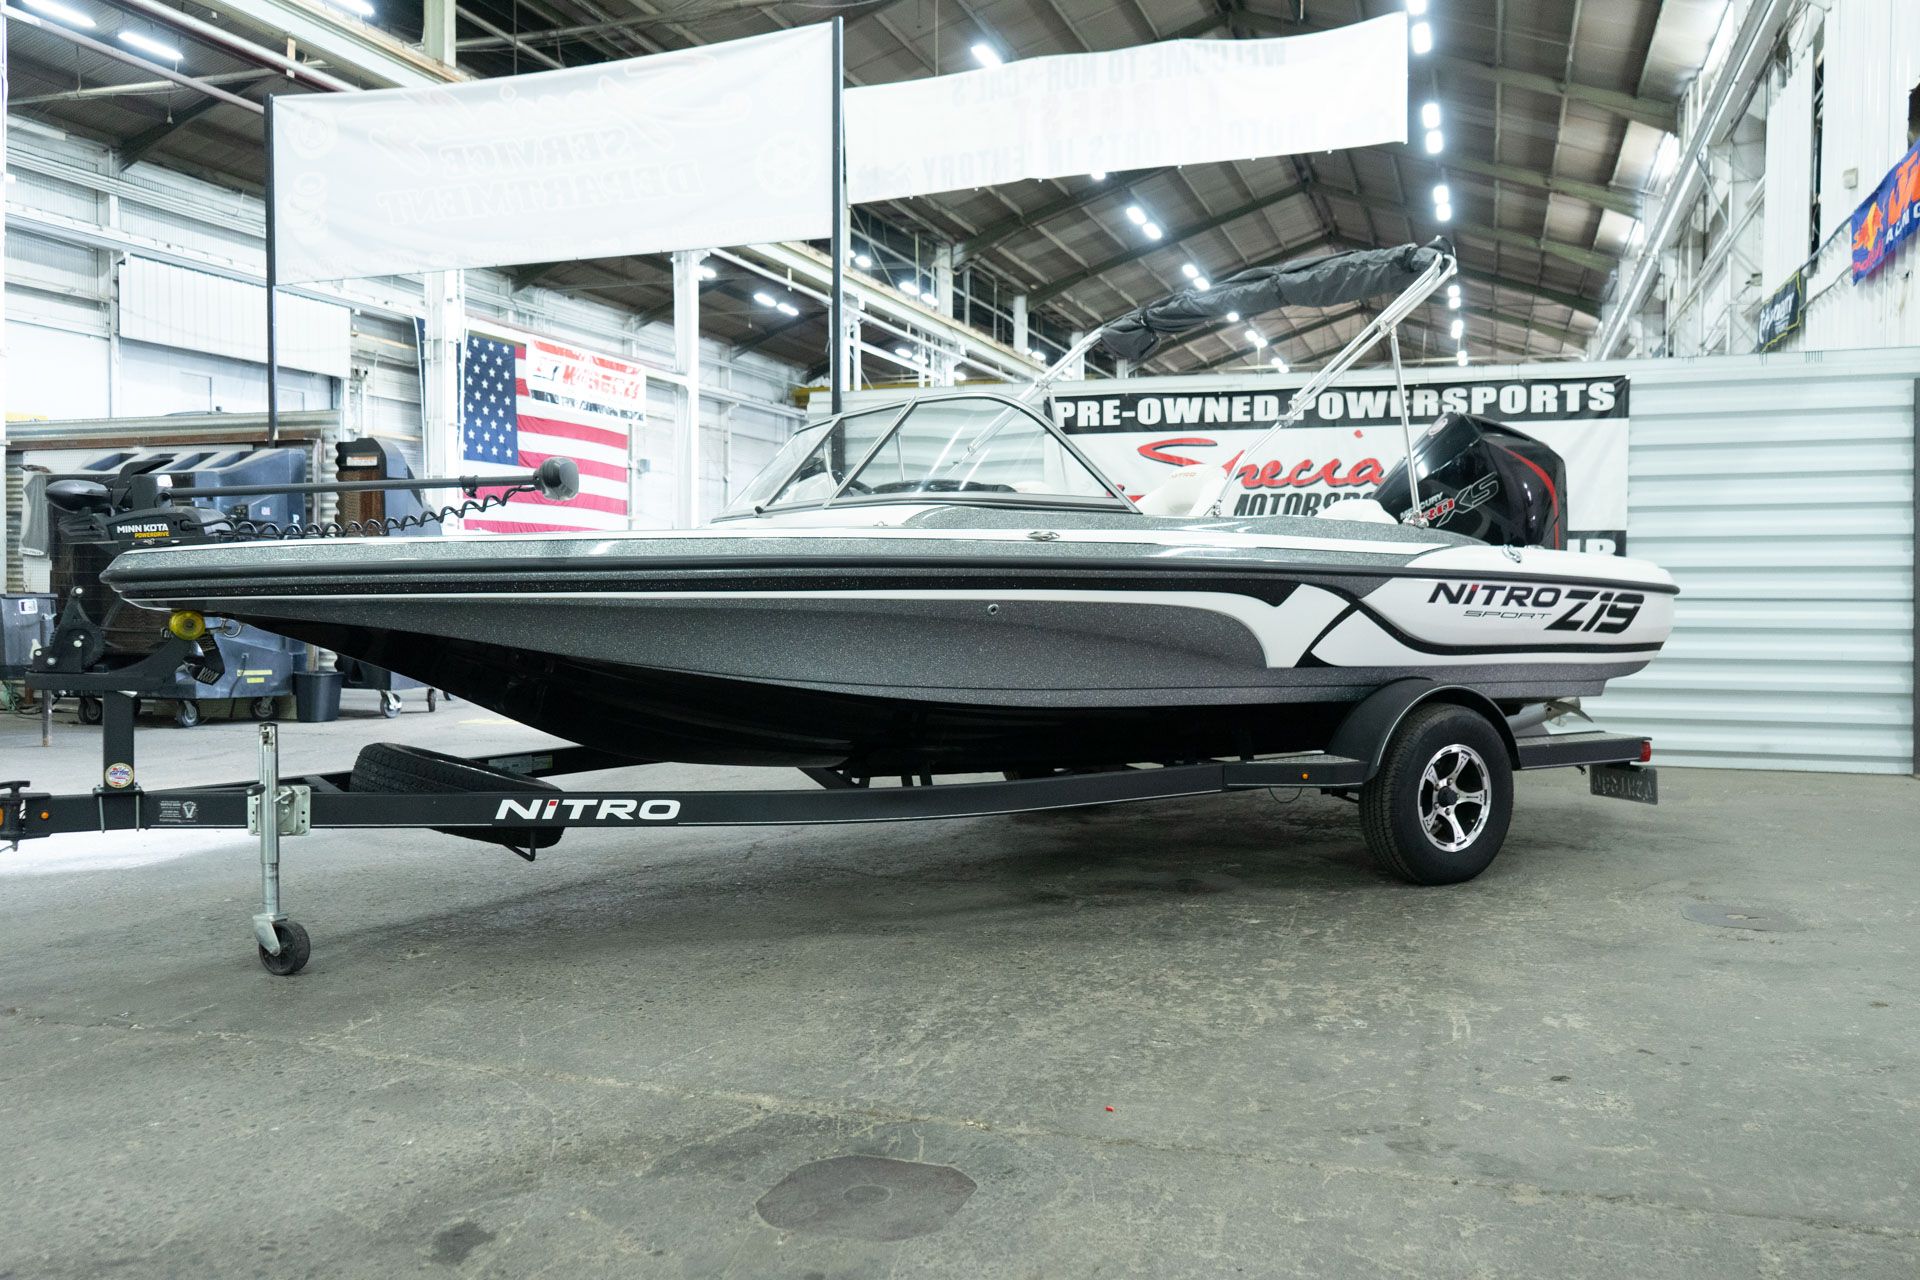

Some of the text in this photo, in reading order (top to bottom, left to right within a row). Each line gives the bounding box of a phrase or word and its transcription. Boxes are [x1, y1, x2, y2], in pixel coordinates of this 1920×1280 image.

[1055, 381, 1617, 428] PRE-OWNED POWERSPORTS
[116, 523, 169, 534] MINN KOTA
[134, 531, 170, 539] POWERDRIVE
[1427, 582, 1645, 634] NITRO Z19
[1463, 610, 1552, 620] SPORT
[495, 799, 681, 820] NITRO
